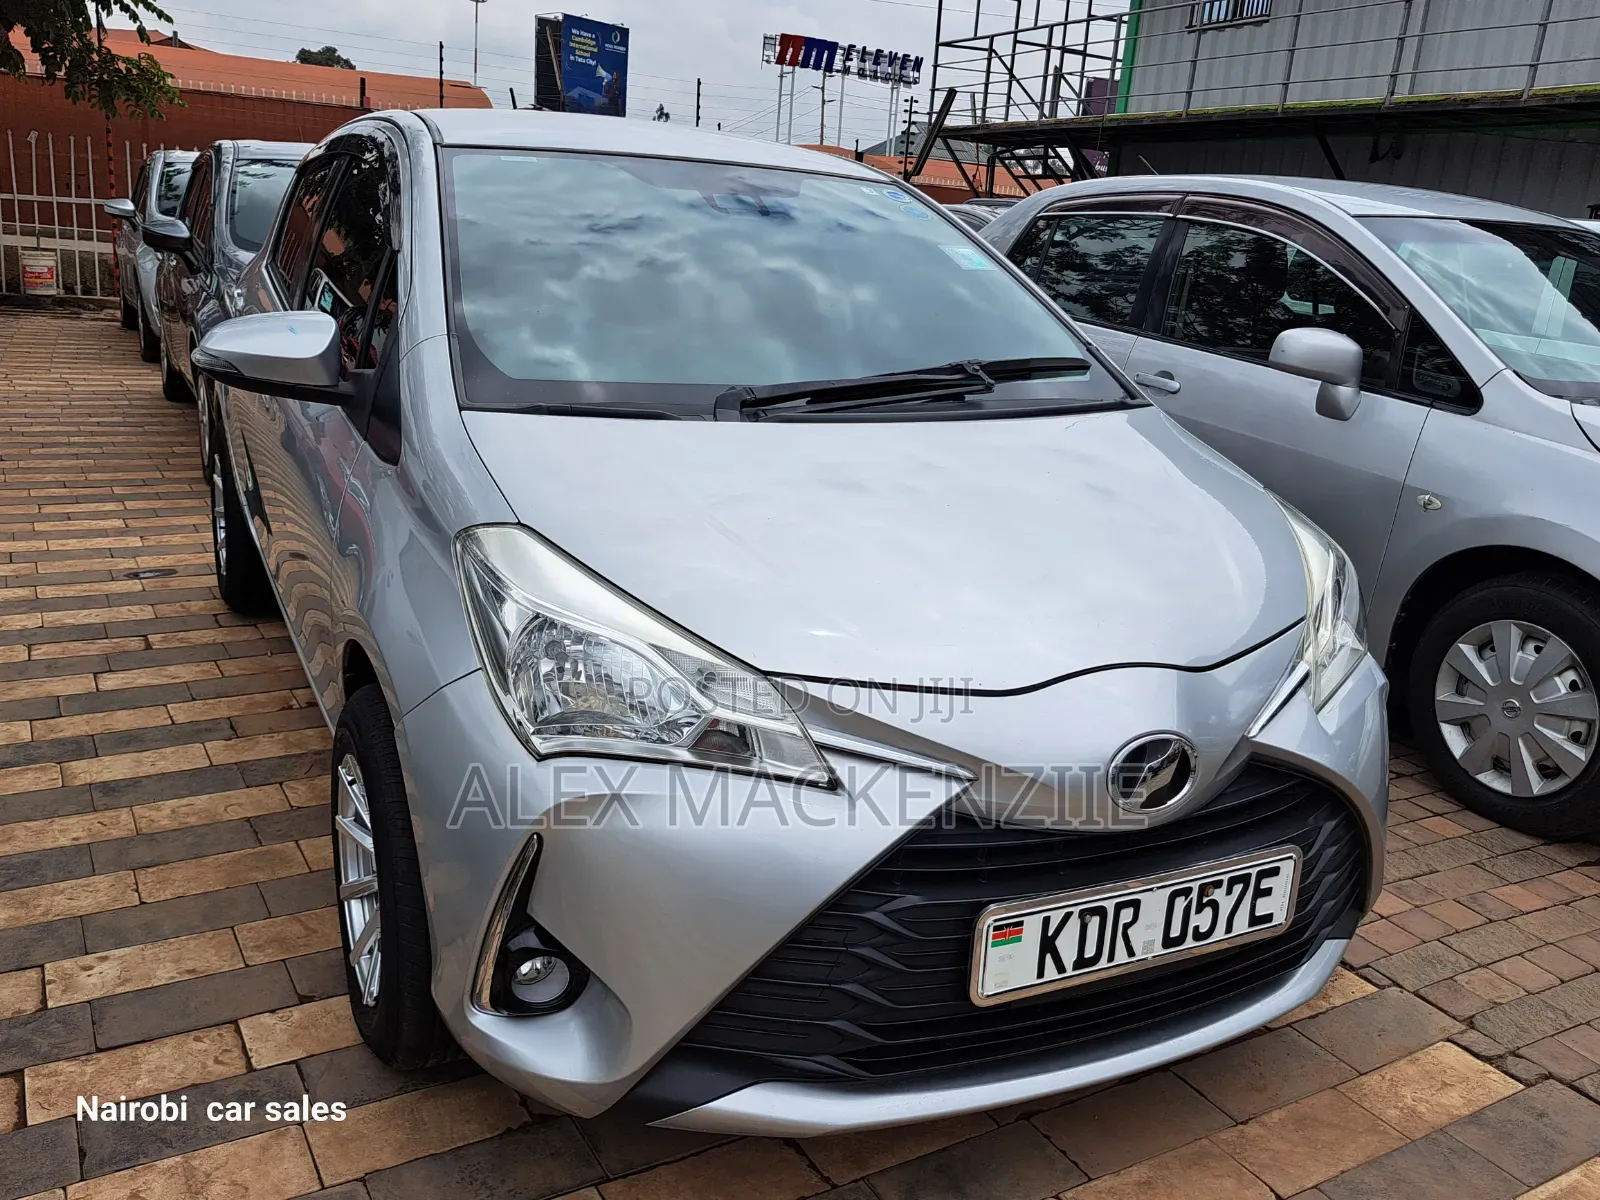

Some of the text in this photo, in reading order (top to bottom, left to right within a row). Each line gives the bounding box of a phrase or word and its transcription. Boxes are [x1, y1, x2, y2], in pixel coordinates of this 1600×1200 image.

[580, 30, 591, 38] Have
[571, 35, 596, 46] Cambridge
[569, 41, 599, 53] International
[575, 49, 591, 58] School
[844, 44, 924, 72] ELEVEN
[842, 65, 920, 85] MOTORS
[1036, 898, 1141, 979] KDR
[1161, 866, 1281, 950] 057E
